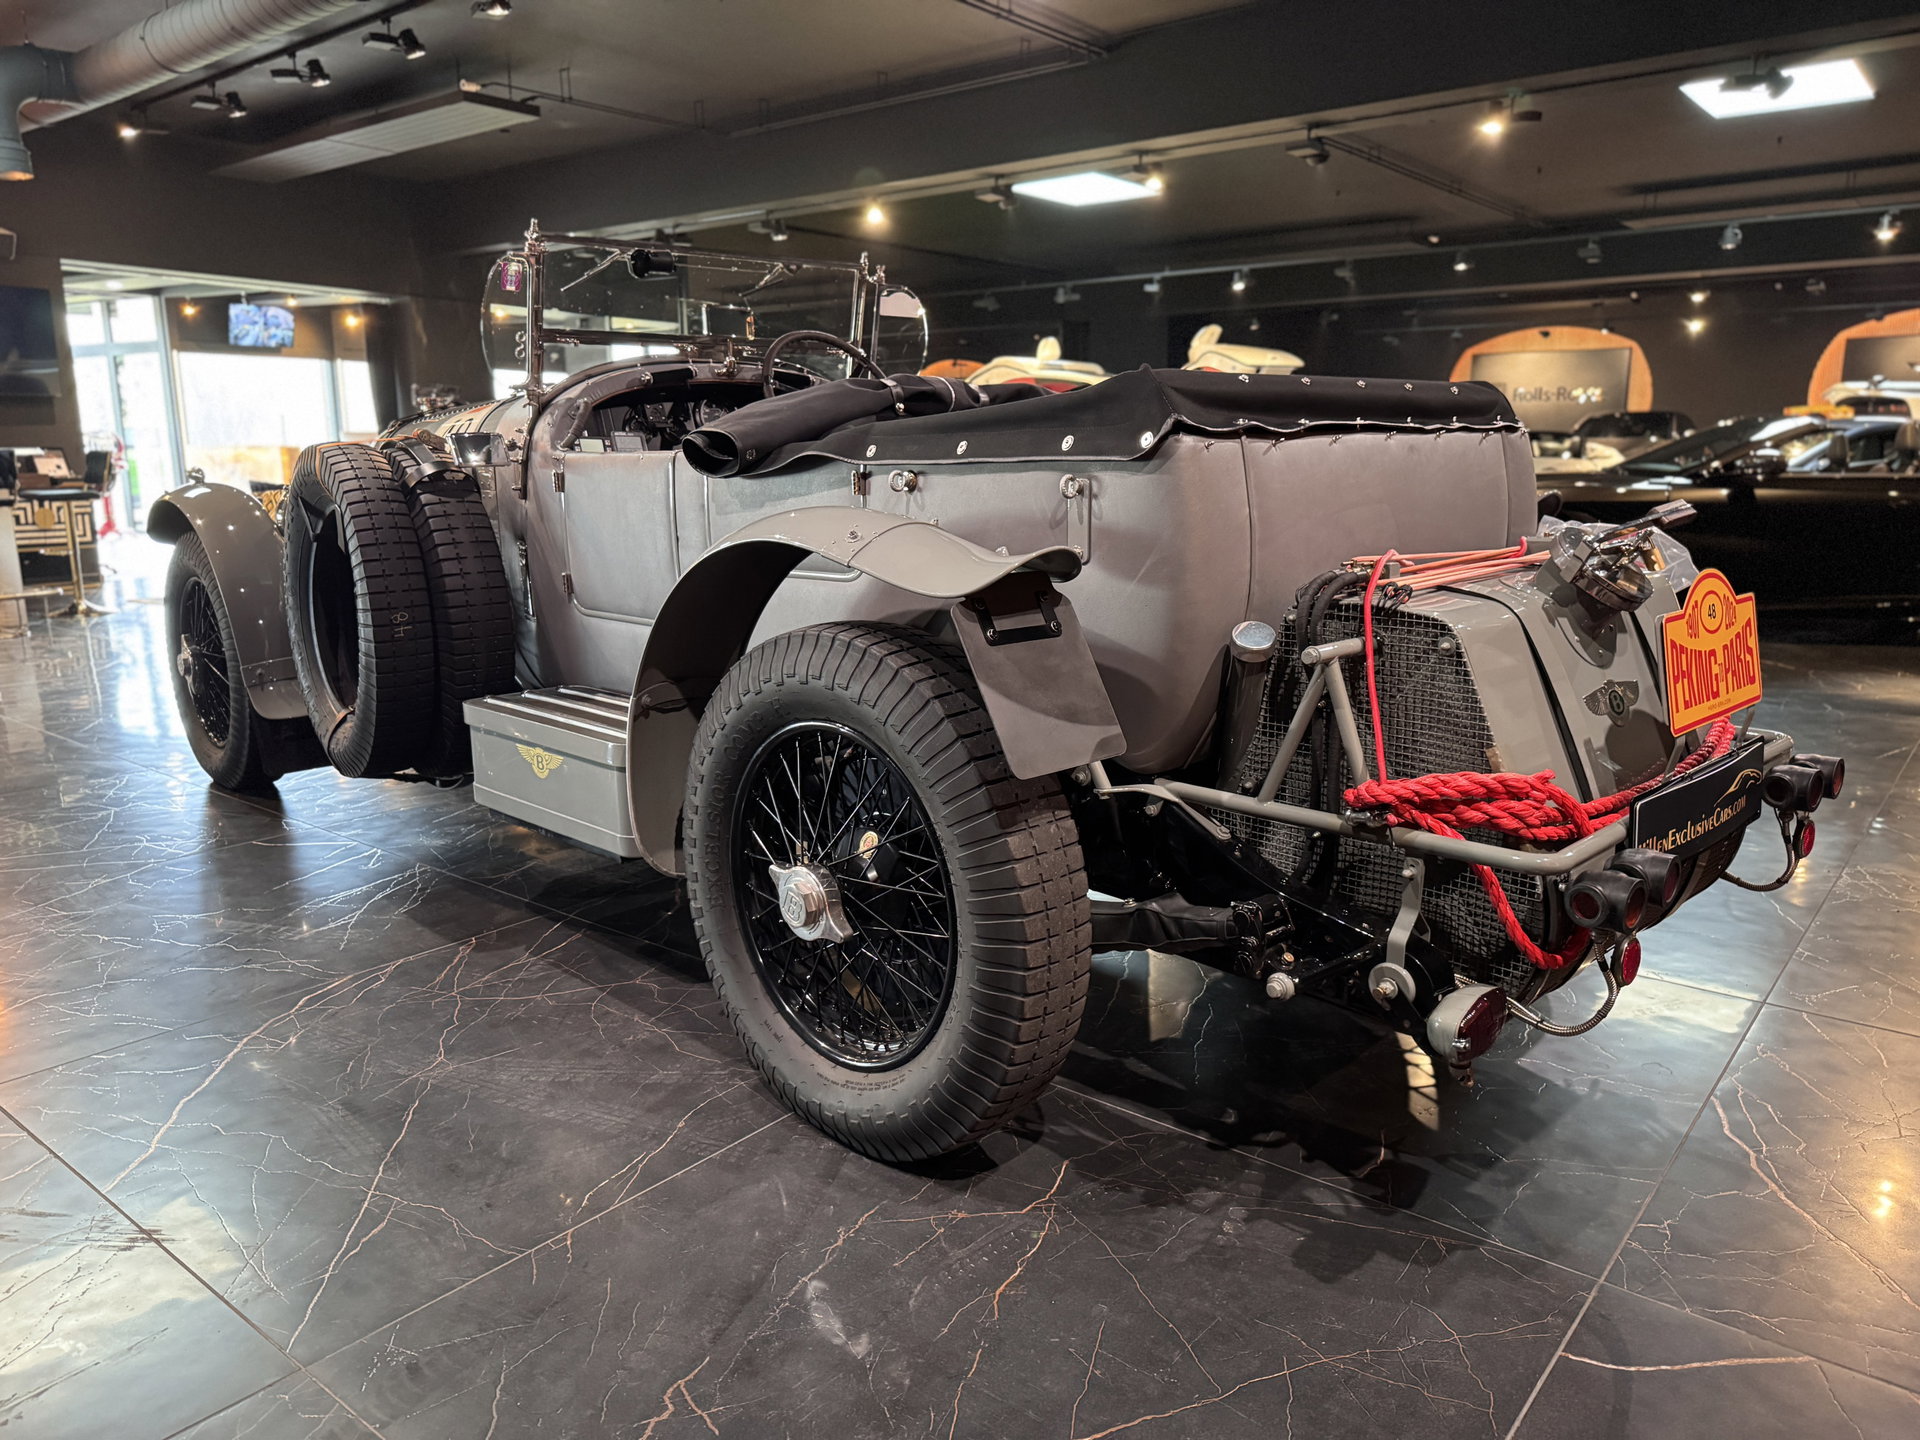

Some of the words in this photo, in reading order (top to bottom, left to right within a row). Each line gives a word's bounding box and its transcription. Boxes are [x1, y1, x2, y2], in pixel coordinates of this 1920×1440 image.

[1513, 386, 1604, 403] Rolls-Ro
[1686, 599, 1700, 640] 1907
[1707, 603, 1717, 620] 48
[1669, 638, 1721, 714] PEKING
[1721, 616, 1757, 695] PARIS
